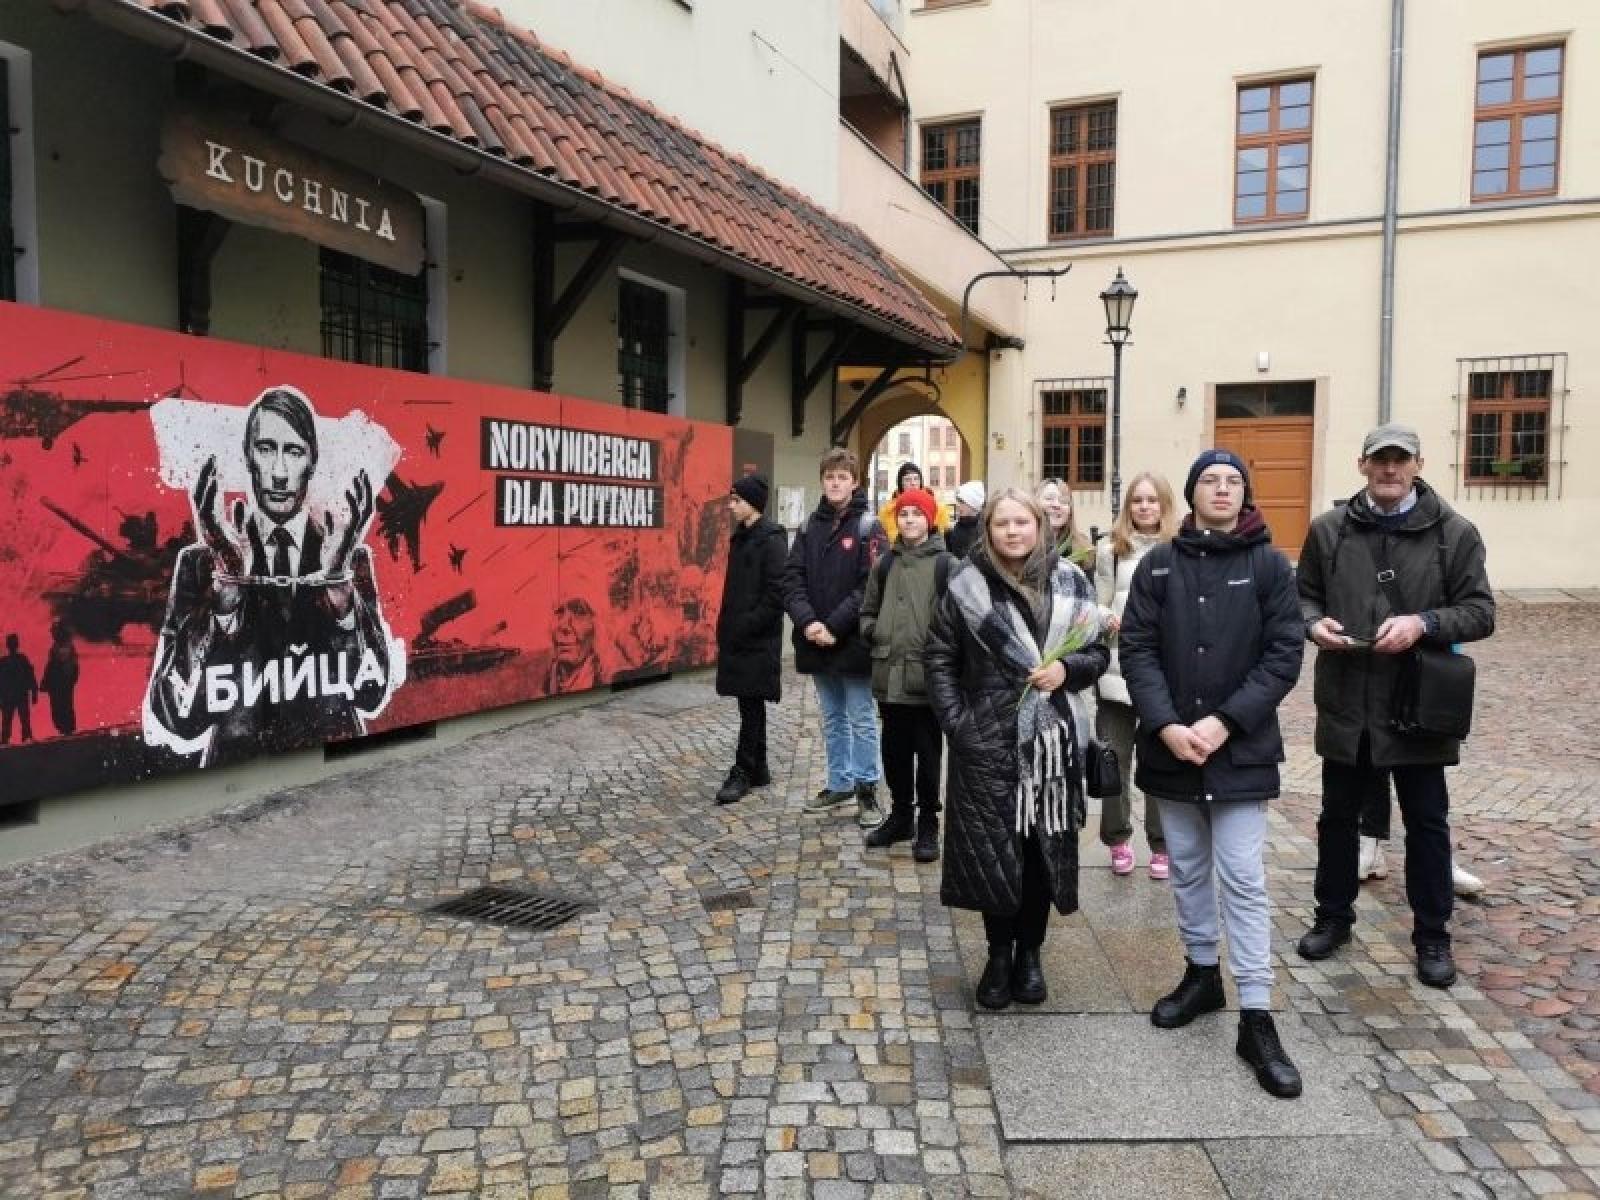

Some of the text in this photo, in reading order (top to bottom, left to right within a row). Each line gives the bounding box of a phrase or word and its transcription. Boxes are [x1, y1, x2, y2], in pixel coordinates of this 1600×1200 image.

[205, 140, 396, 240] KUCHNIA
[490, 421, 651, 480] NORYMBERGA
[503, 479, 653, 527] DLA PUTINA!
[168, 642, 387, 719] УБИЙЦА
